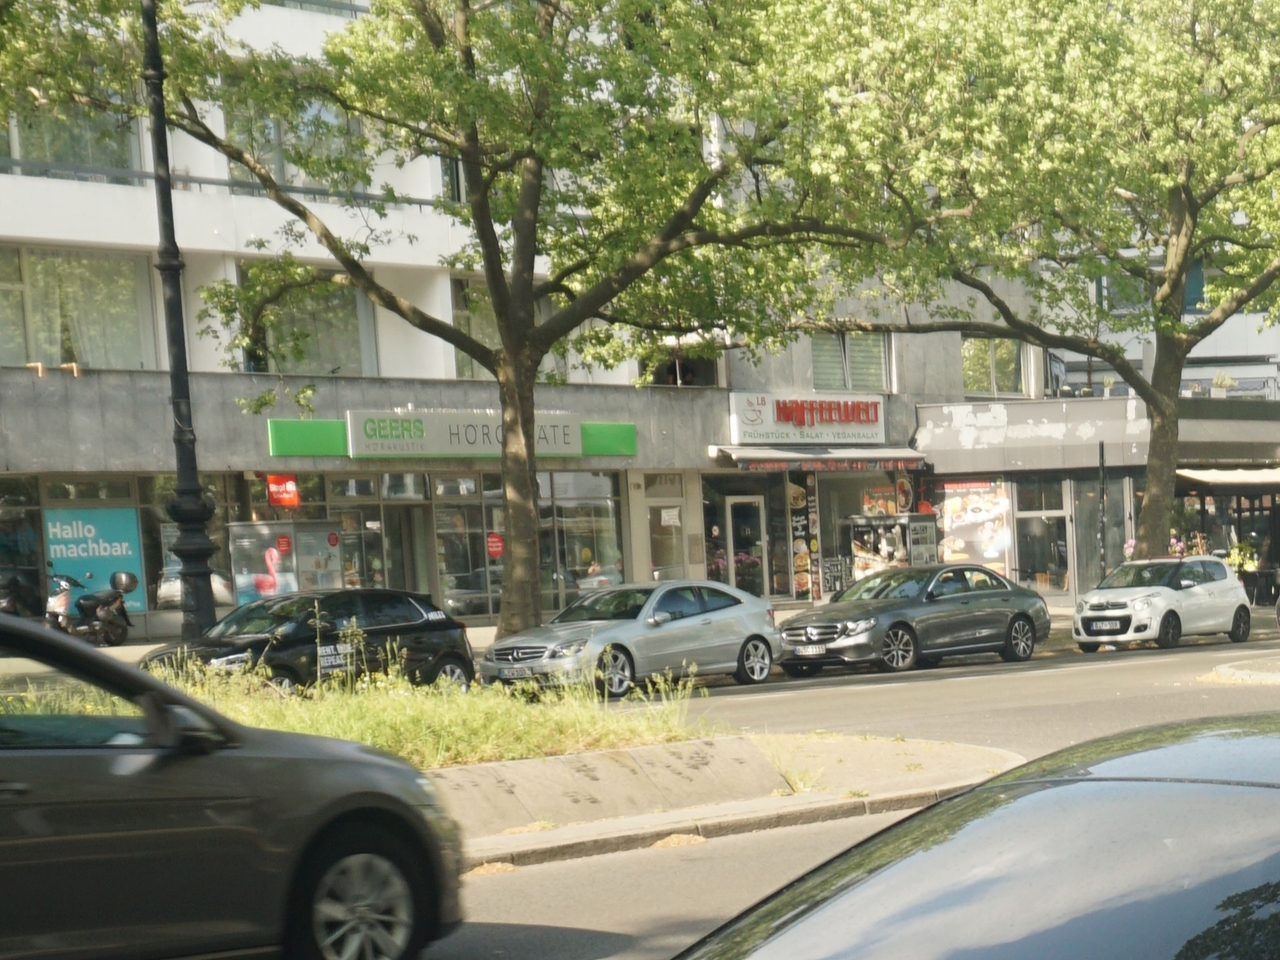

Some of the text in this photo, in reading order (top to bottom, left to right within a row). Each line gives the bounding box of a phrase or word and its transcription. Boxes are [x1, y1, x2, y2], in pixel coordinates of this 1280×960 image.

[363, 417, 426, 440] GEERS
[449, 423, 571, 446] HÖRÄTE
[743, 430, 790, 439] FRÜHSTÜCK
[800, 431, 823, 439] SALAT
[48, 521, 95, 538] Hallo
[50, 539, 132, 558] machbar.
